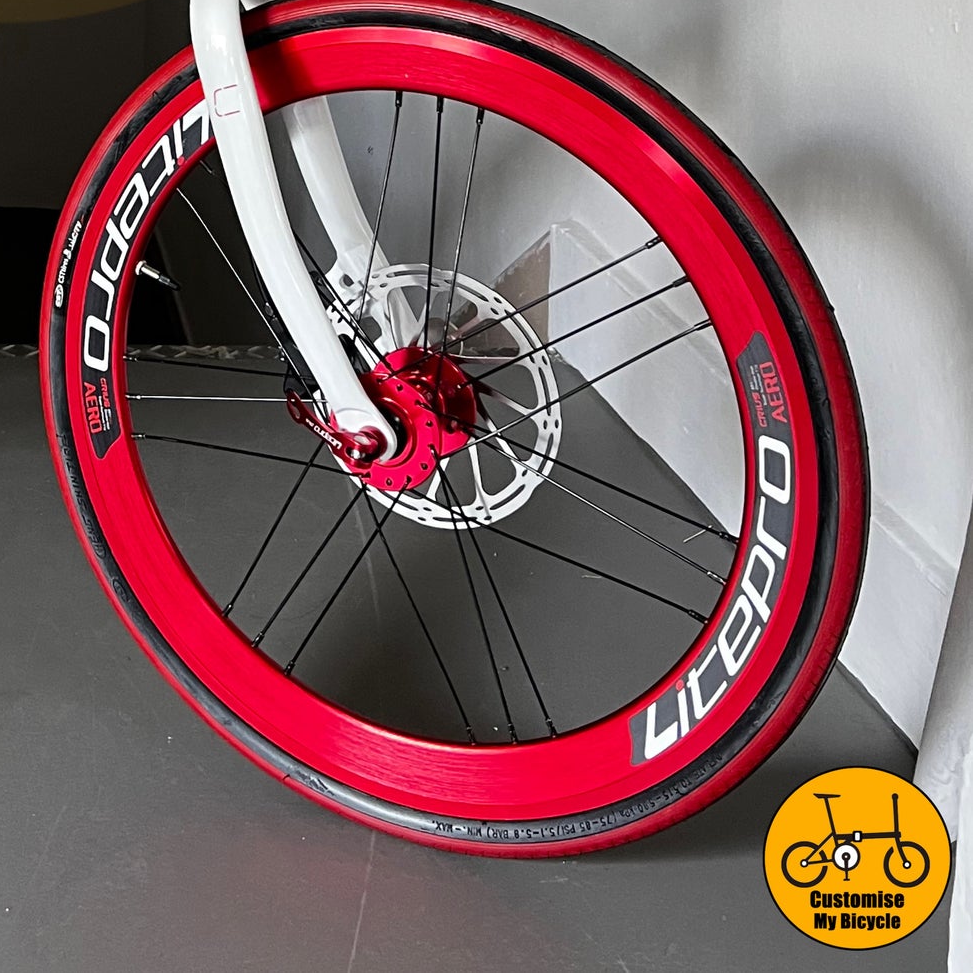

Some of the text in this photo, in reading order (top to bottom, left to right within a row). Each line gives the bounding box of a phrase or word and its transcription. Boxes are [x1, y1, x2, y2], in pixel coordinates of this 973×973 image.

[84, 382, 102, 434] AERO
[759, 361, 788, 423] AERO
[644, 434, 791, 760] Litepro
